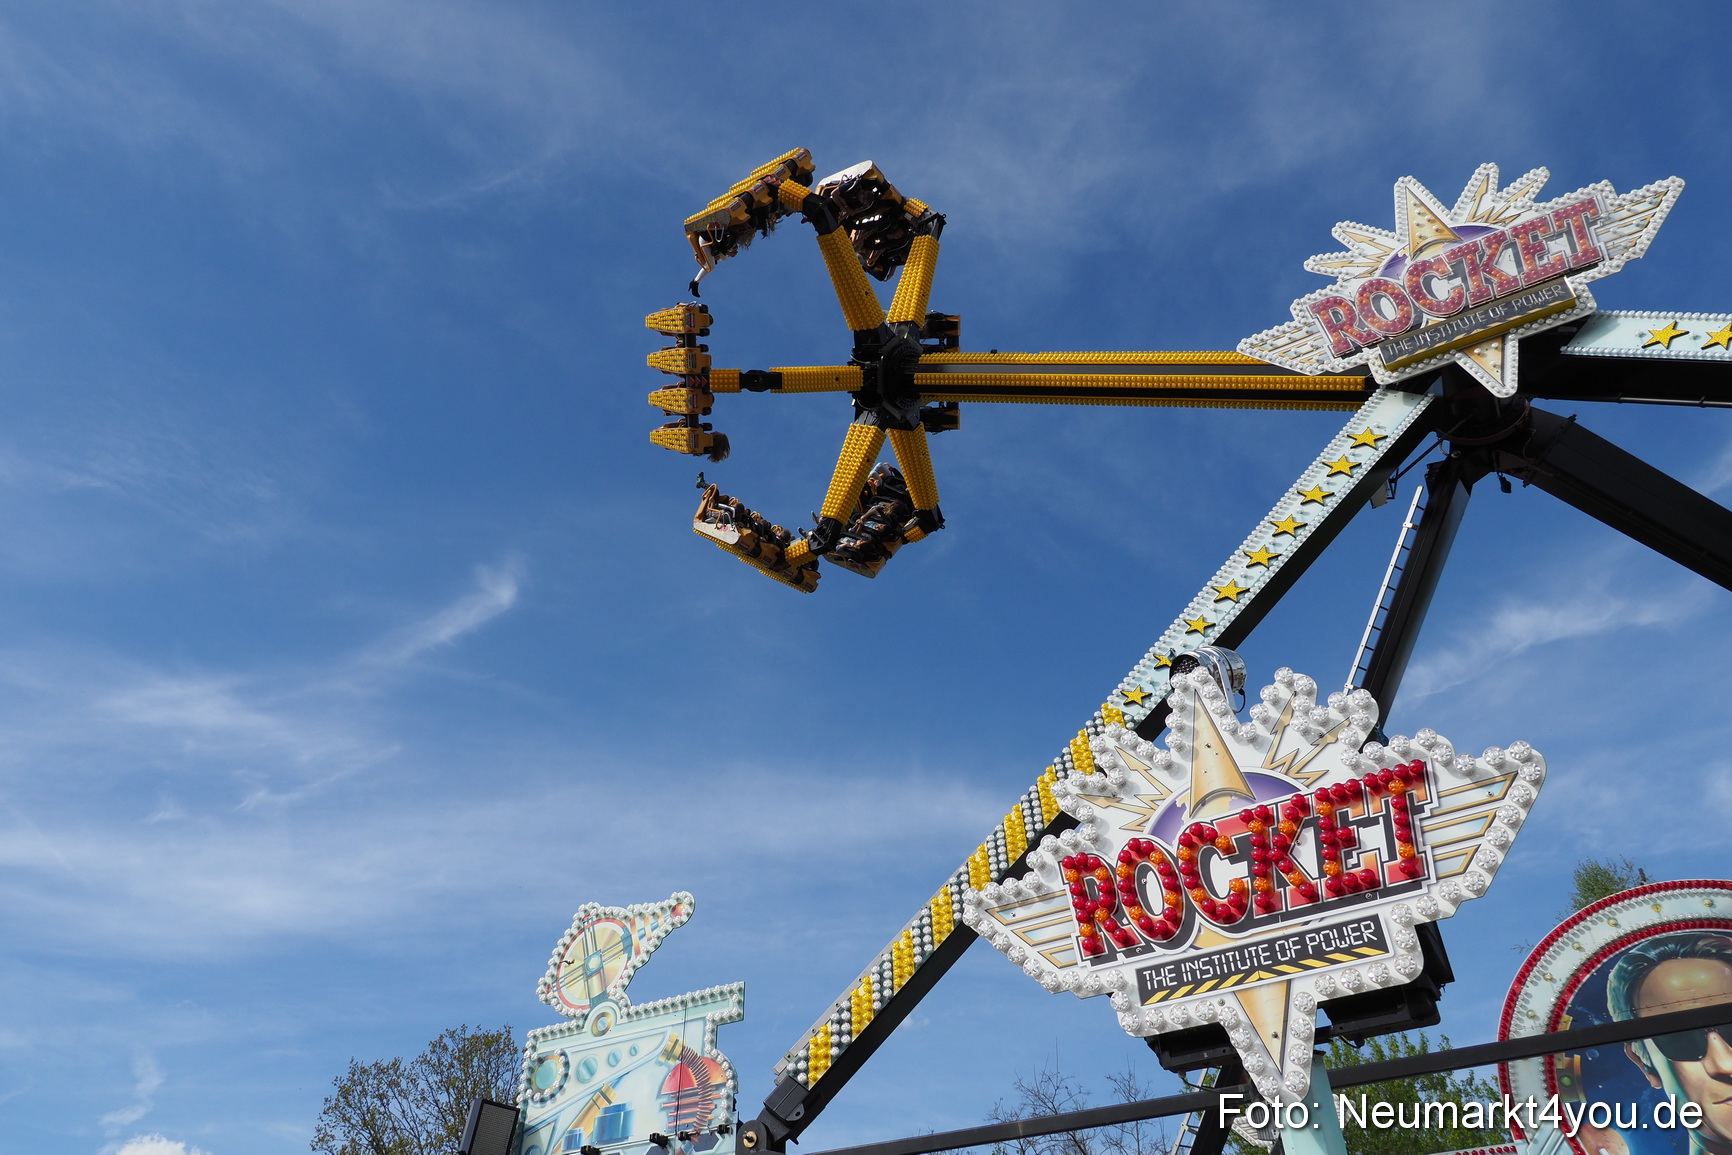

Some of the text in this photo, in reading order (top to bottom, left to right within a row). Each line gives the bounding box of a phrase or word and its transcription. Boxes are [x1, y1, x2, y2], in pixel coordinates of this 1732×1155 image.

[1306, 196, 1603, 358] ROCKET
[1385, 284, 1566, 356] THE INSTITUTE OF POWER
[1060, 759, 1432, 958] ROCKET
[1143, 920, 1378, 990] THE INSTITUTE OF POWER
